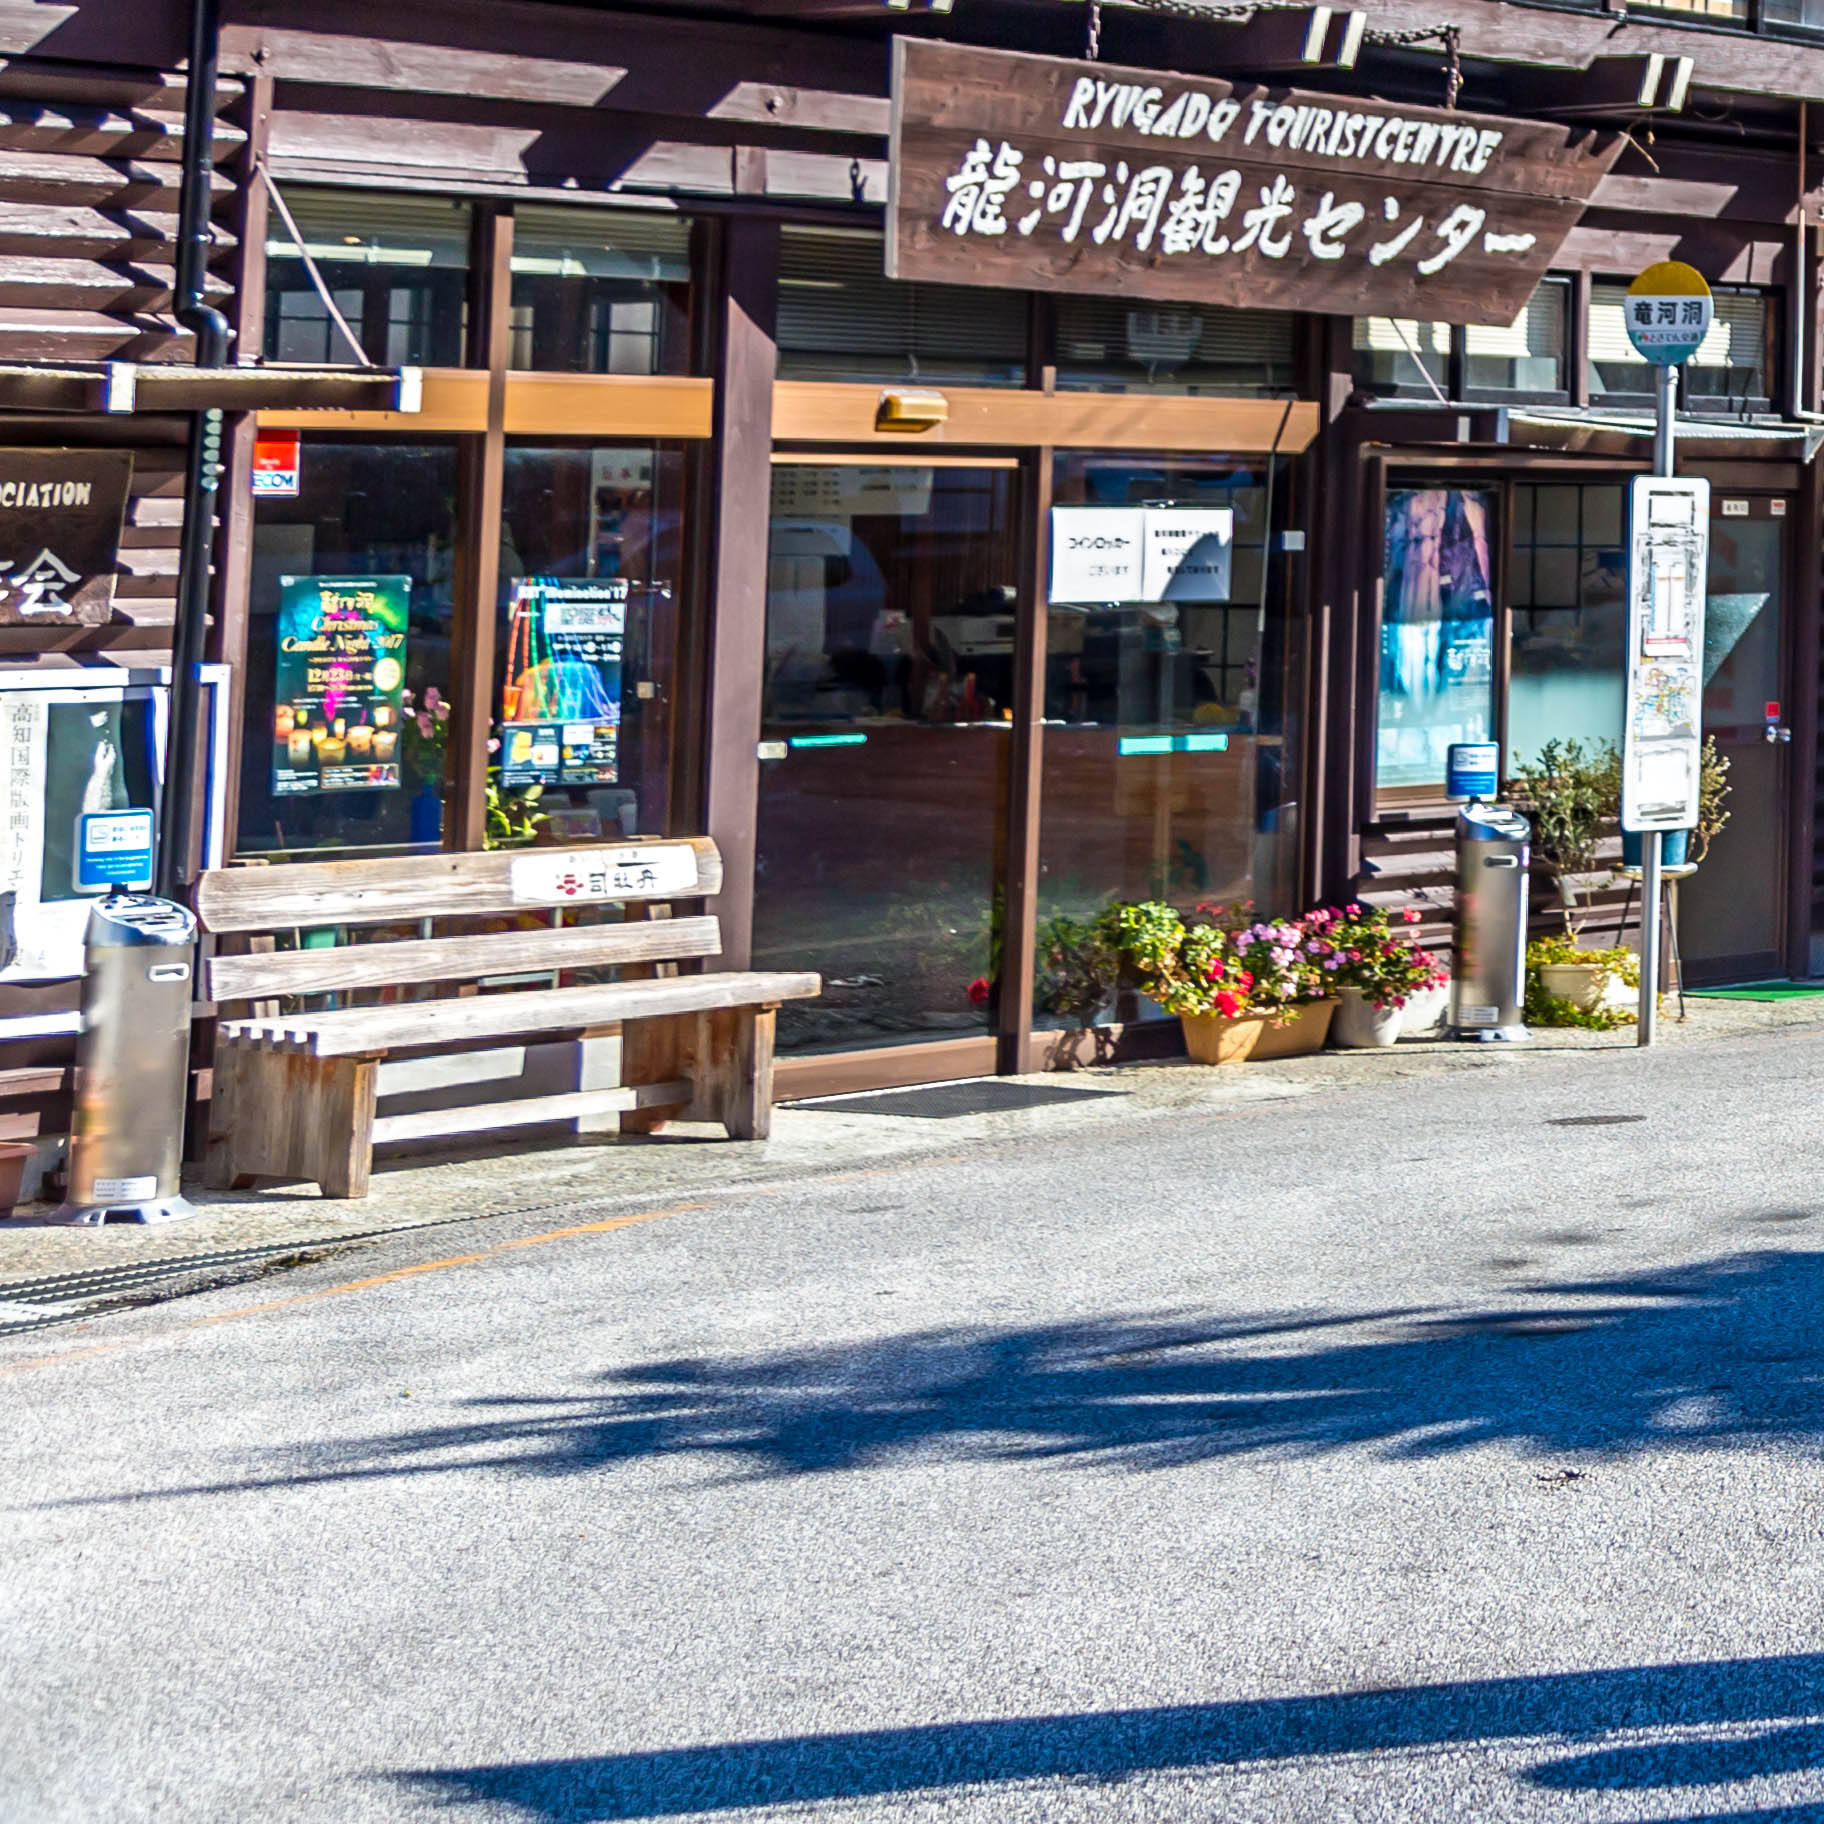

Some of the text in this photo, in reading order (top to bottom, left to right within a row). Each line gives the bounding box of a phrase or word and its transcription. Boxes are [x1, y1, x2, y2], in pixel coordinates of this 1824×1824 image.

[1063, 76, 1242, 143] RYUGADO
[942, 137, 1537, 276] 龍河洞観光センター
[1633, 301, 1704, 326] 竜河洞
[0, 482, 92, 507] CIATION
